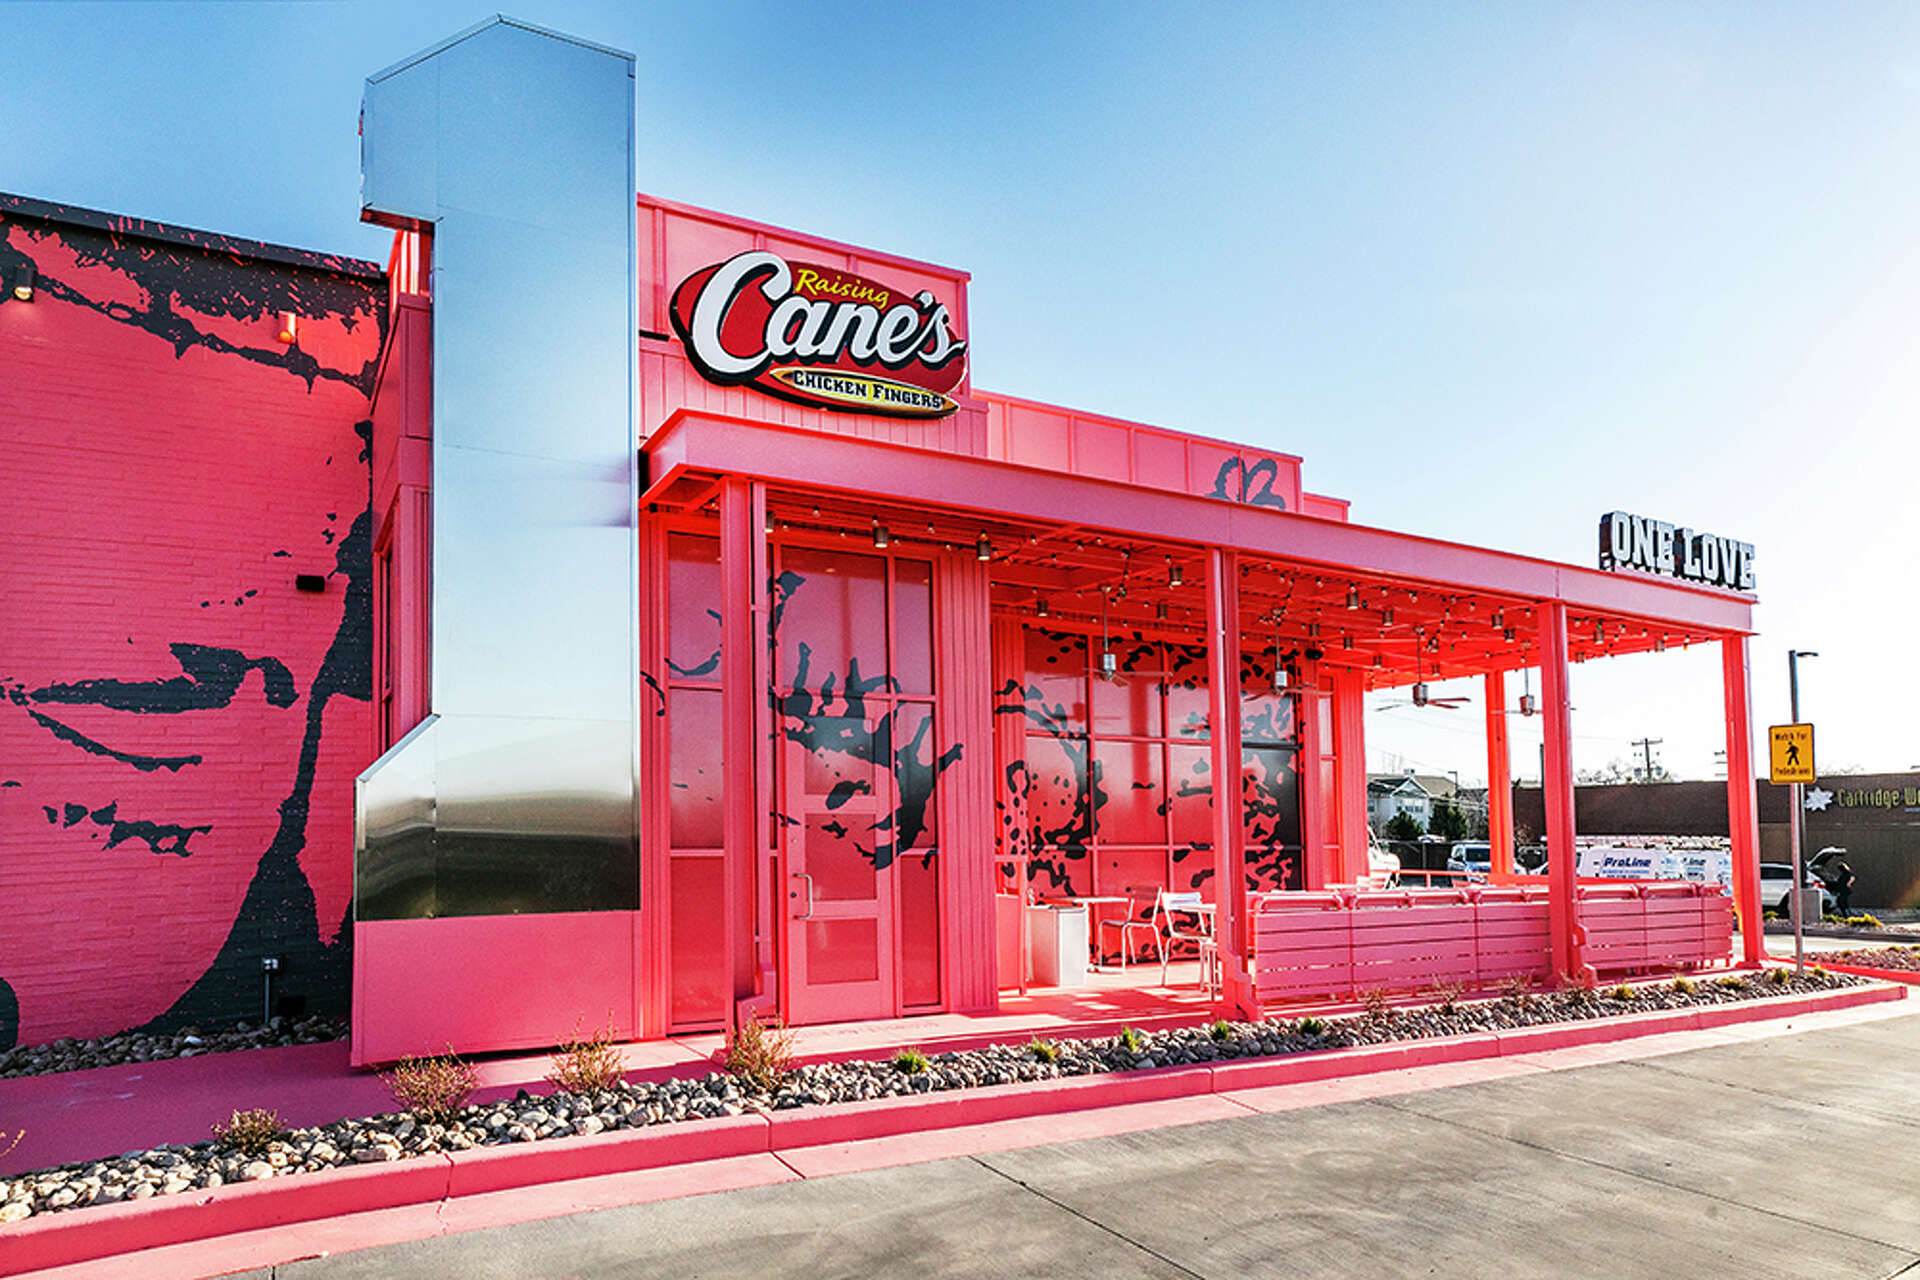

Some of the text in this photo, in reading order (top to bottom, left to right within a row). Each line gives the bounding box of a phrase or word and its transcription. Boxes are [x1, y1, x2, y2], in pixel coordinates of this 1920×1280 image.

[795, 269, 890, 310] Raising
[692, 251, 967, 374] Cane's
[793, 370, 943, 409] CHICKEN FINGERS
[1609, 511, 1756, 589] ONE LOVE
[1838, 787, 1920, 809] Cartridge W
[1603, 857, 1652, 868] ProLine
